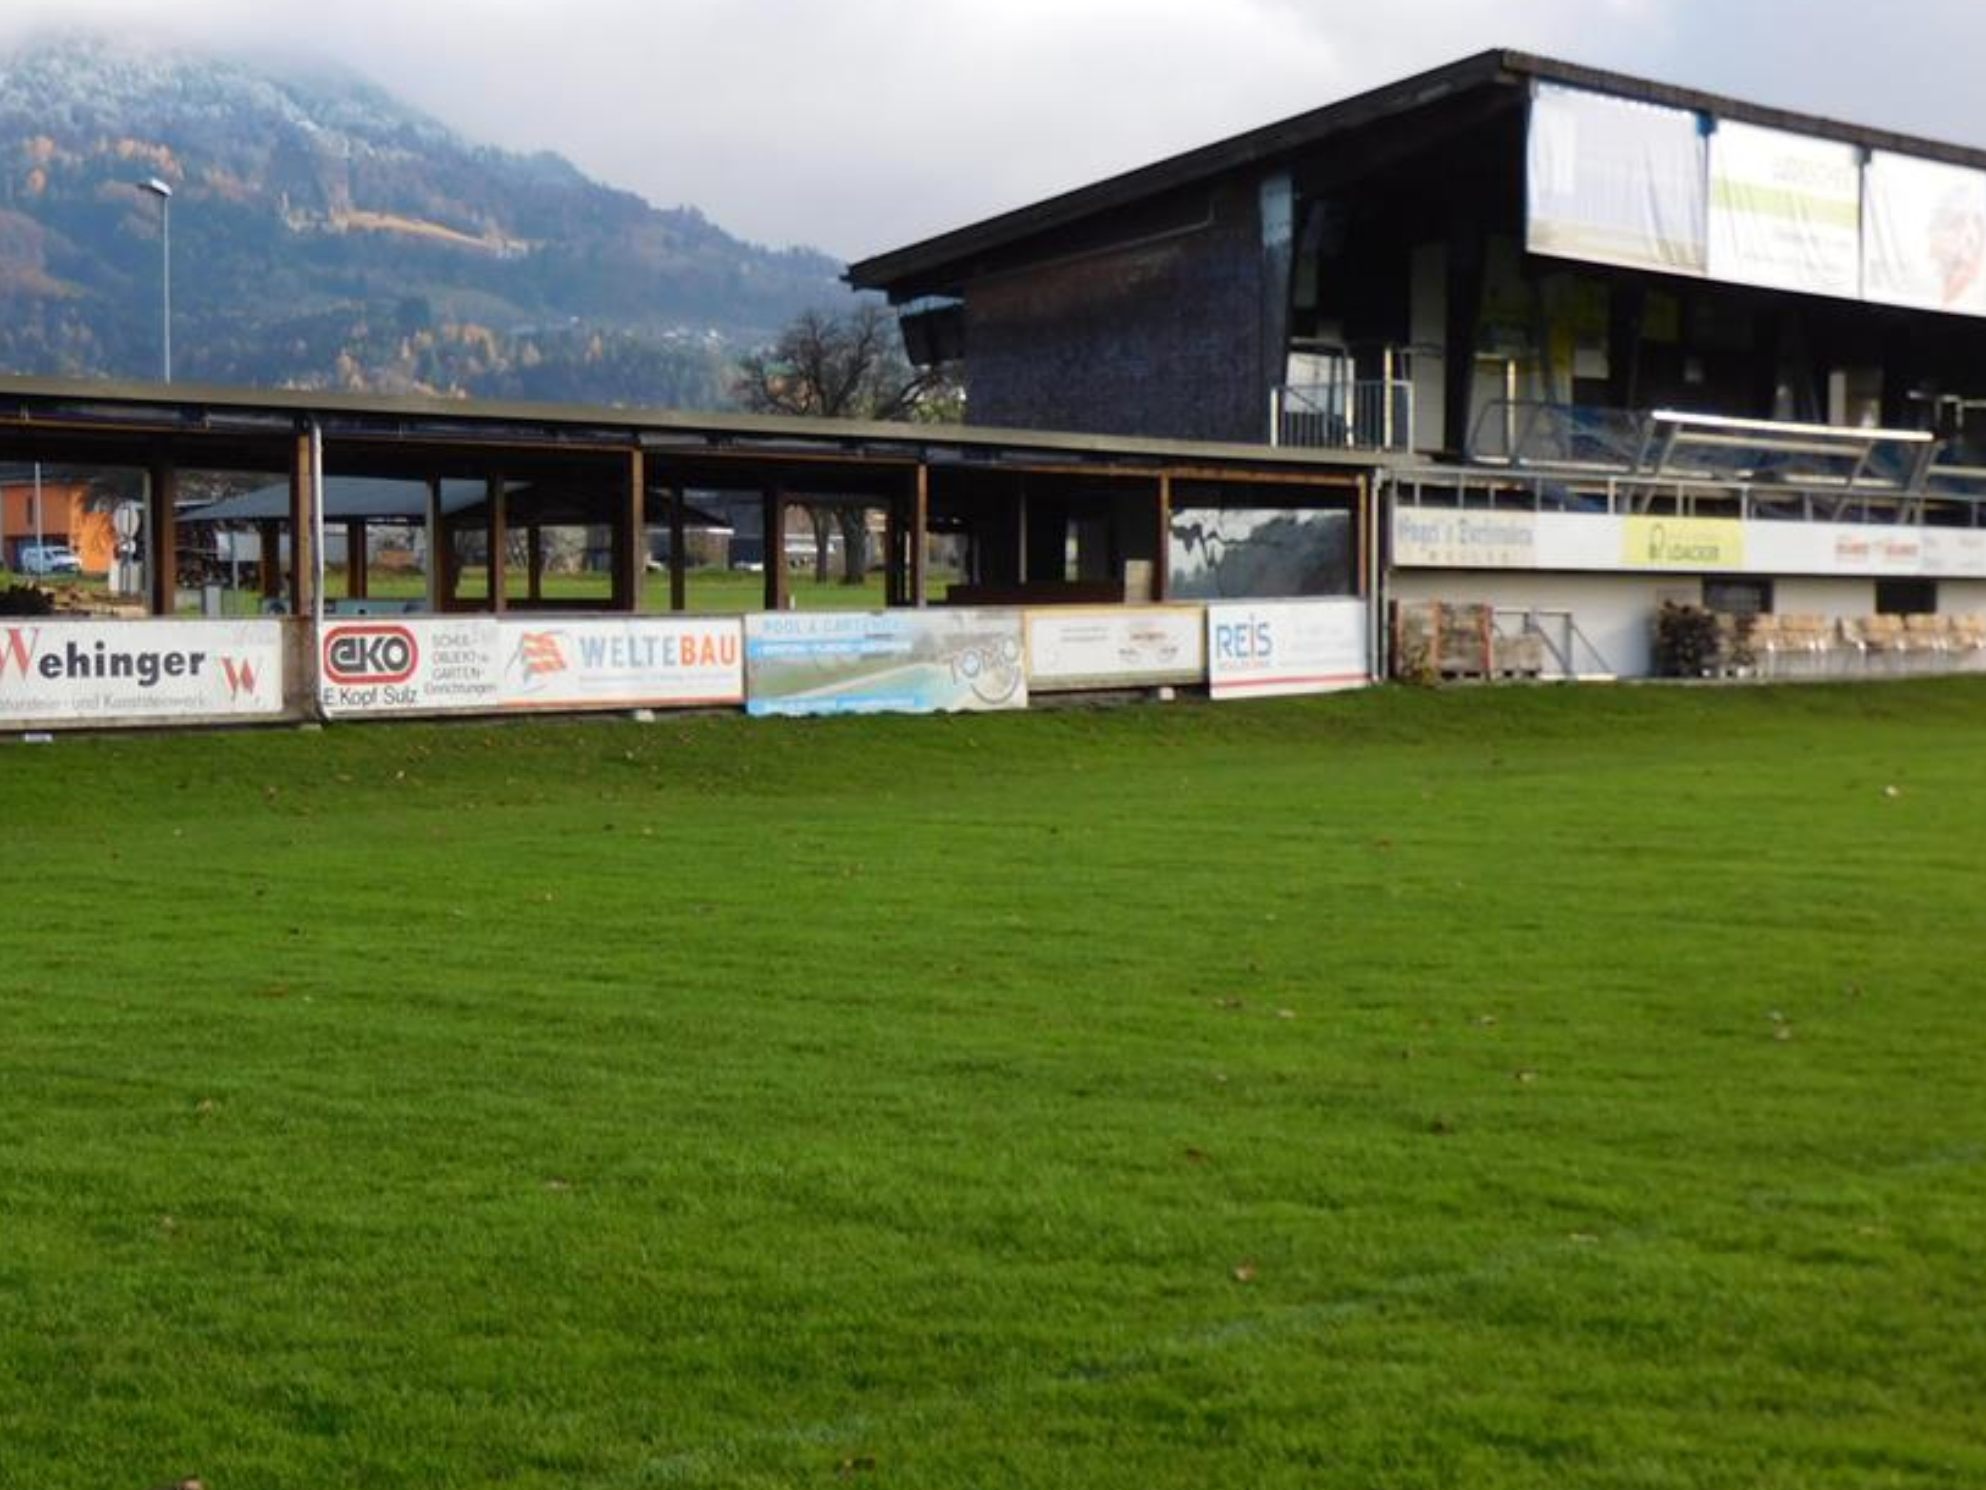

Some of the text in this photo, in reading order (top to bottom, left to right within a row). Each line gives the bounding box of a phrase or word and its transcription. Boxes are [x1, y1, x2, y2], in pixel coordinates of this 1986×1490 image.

[578, 634, 736, 668] WELTEBAU
[1216, 612, 1273, 657] REIS
[383, 687, 418, 704] Sulz
